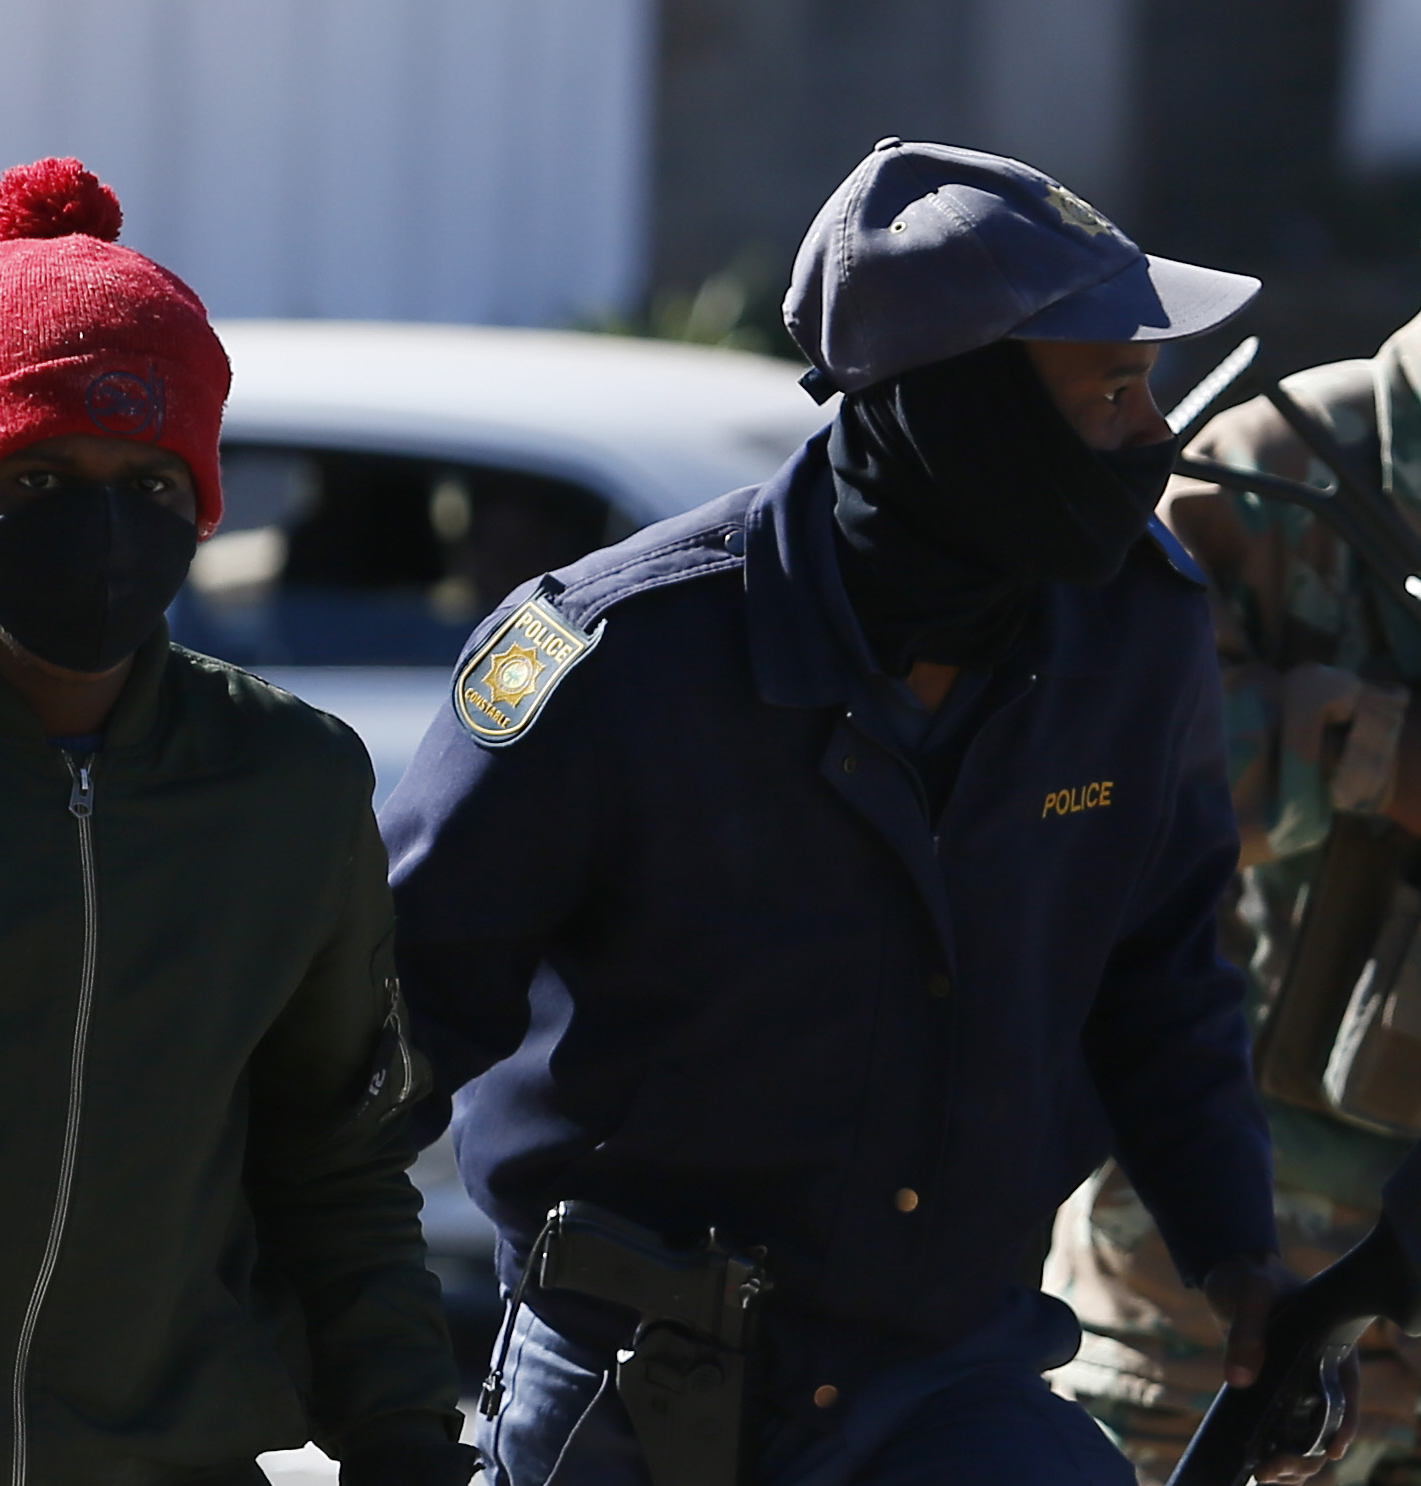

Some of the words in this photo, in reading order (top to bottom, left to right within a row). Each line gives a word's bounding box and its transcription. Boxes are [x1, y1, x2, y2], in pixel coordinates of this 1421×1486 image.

[514, 611, 573, 663] POLICE
[464, 687, 512, 729] CONSTABLE
[1042, 781, 1114, 819] POLICE
